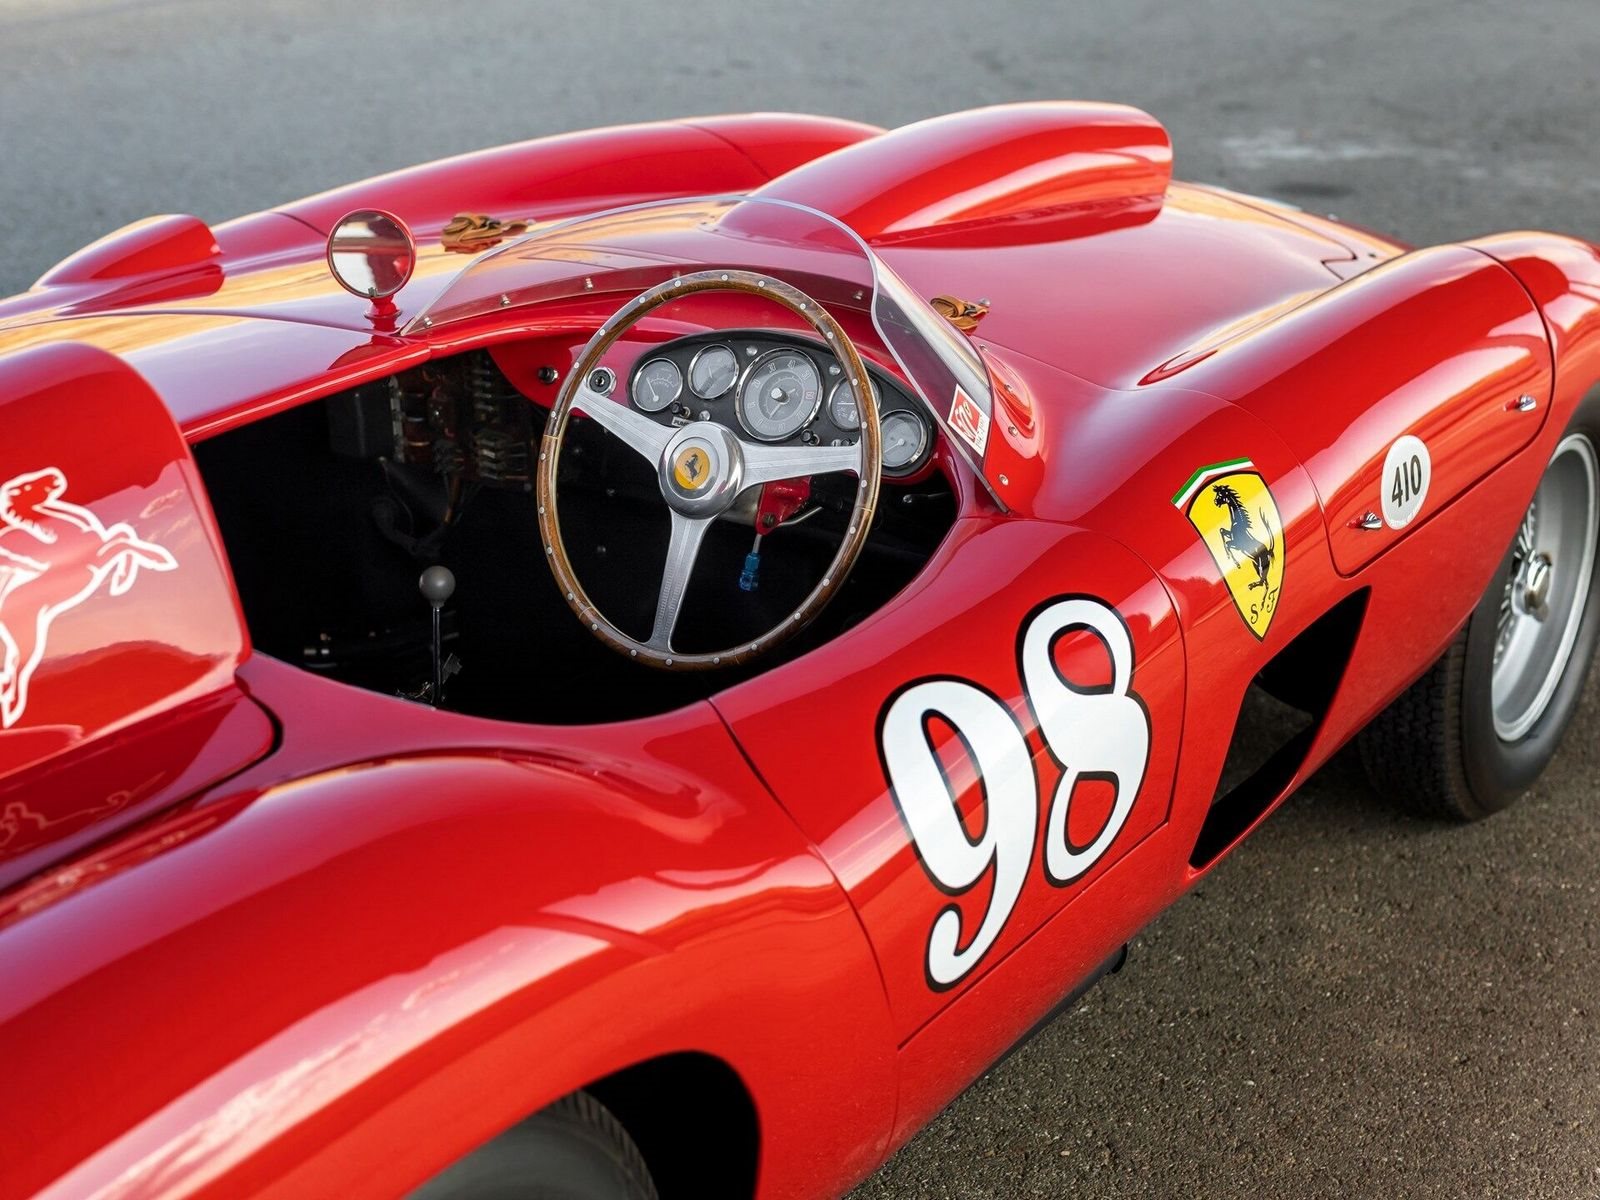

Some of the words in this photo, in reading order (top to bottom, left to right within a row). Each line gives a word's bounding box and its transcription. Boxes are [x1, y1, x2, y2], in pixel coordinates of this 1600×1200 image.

[1391, 454, 1422, 508] 410
[1250, 603, 1259, 625] S
[1266, 586, 1279, 614] F
[874, 592, 1152, 993] 98
